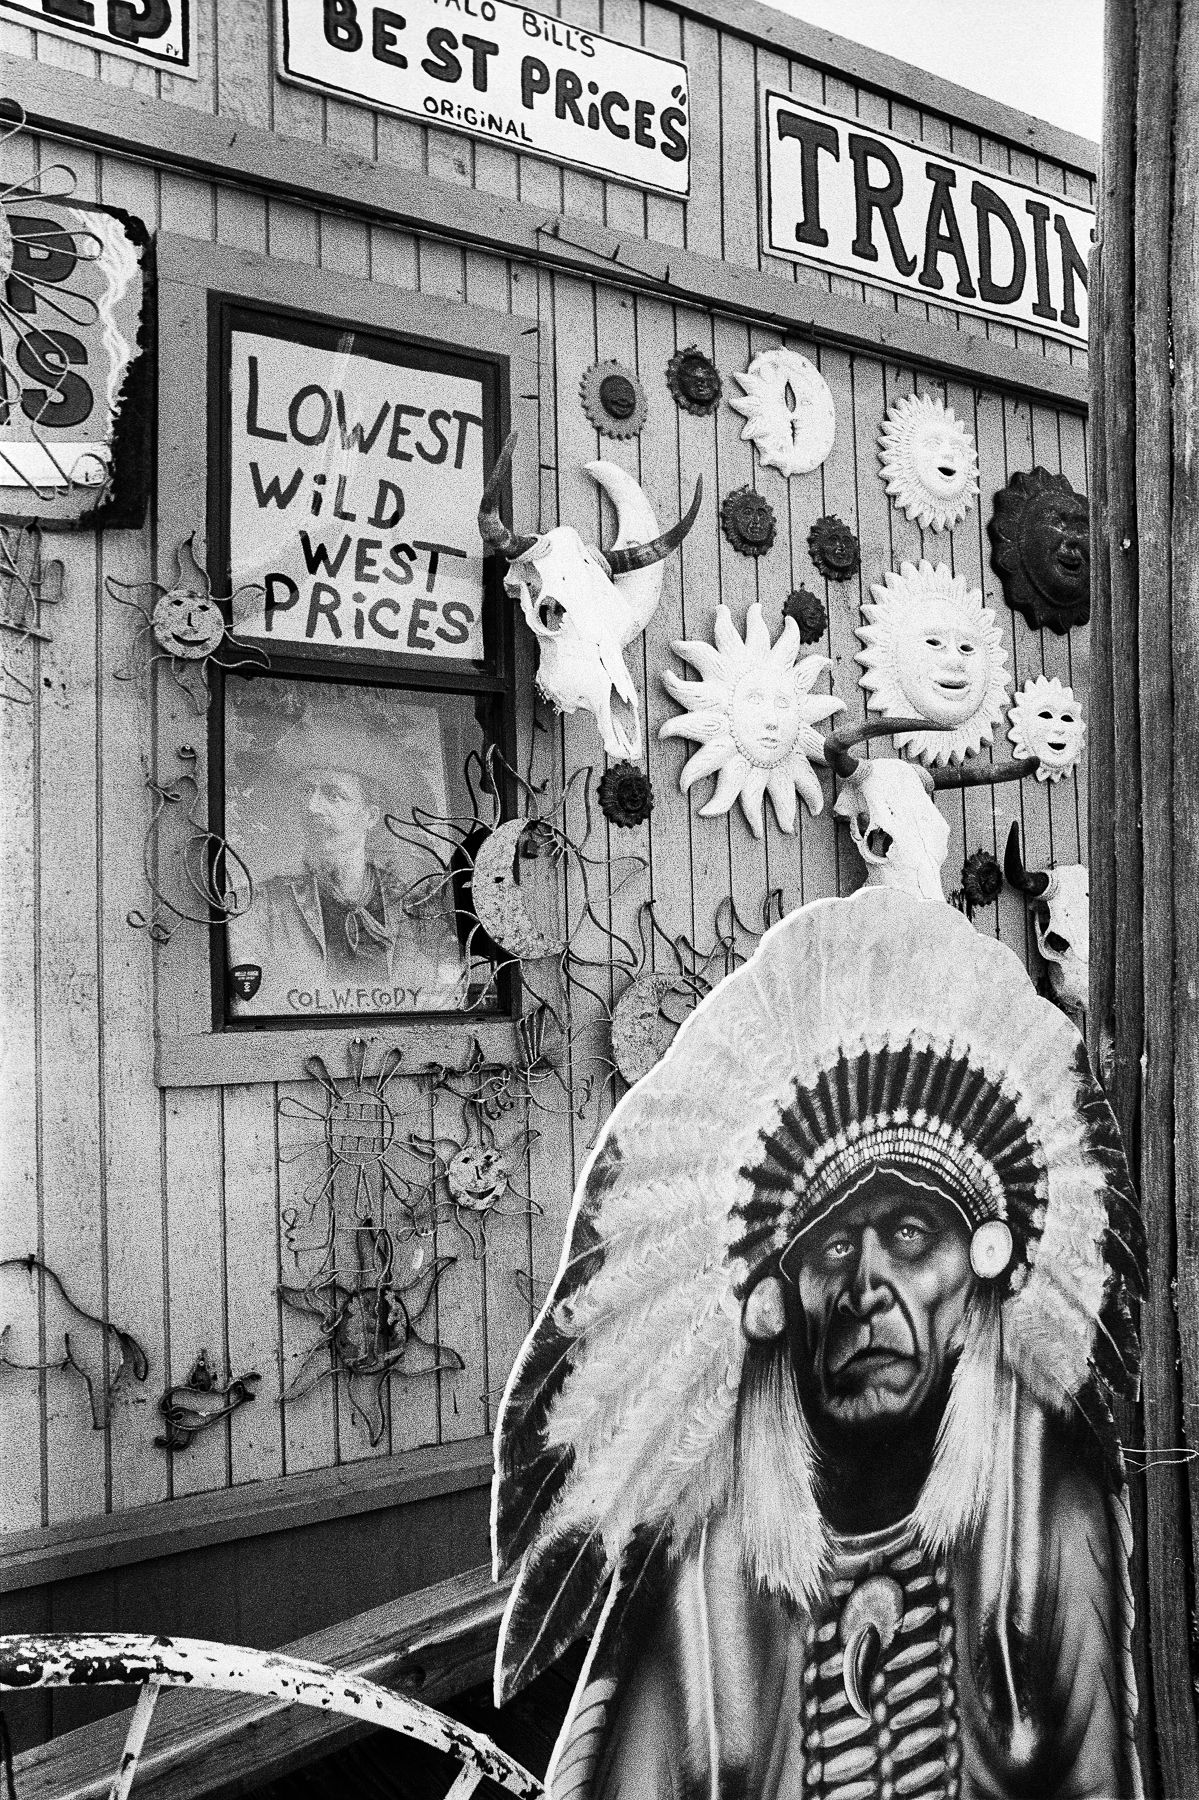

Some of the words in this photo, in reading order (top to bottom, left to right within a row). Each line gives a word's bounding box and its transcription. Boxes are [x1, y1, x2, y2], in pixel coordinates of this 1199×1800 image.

[323, 0, 500, 92] BEST
[247, 355, 482, 469] LOWEST
[299, 530, 467, 593] WEST
